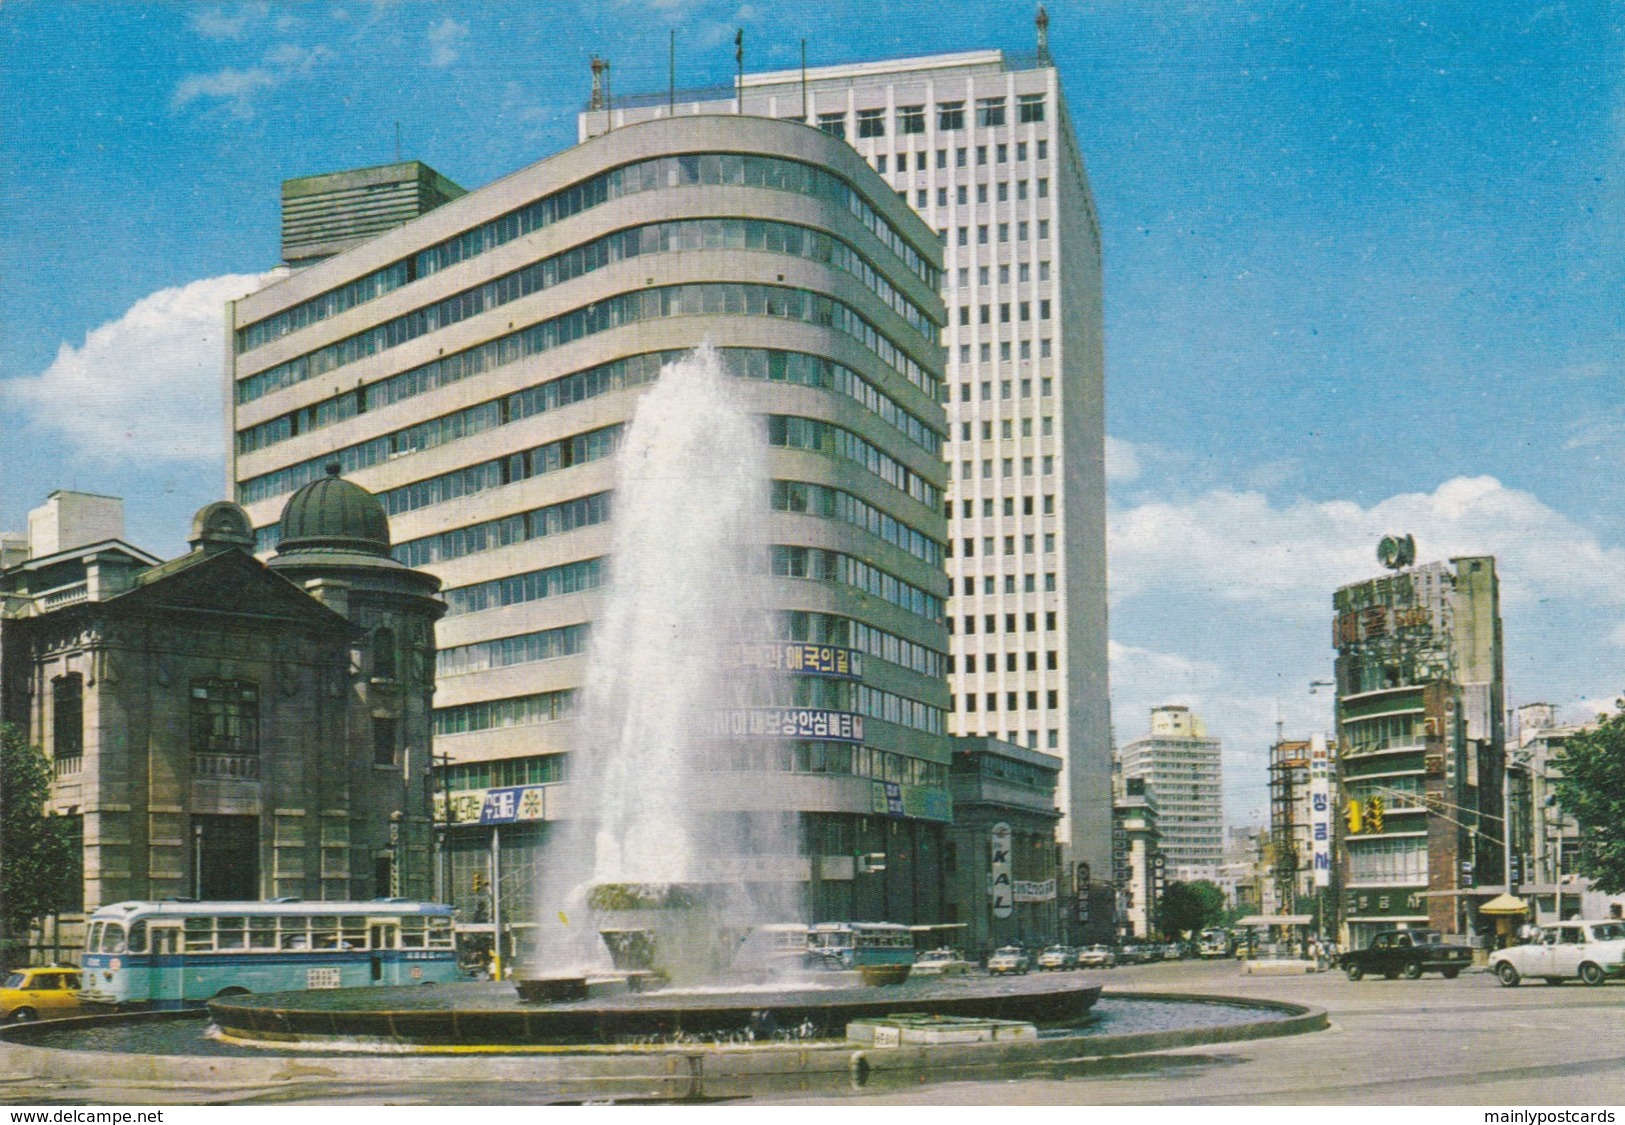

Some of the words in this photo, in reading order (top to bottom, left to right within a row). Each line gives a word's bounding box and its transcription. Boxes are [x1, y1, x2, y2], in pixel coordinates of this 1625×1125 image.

[786, 645, 834, 672] 애국의
[837, 649, 849, 674] 길
[993, 850, 1011, 909] KAL
